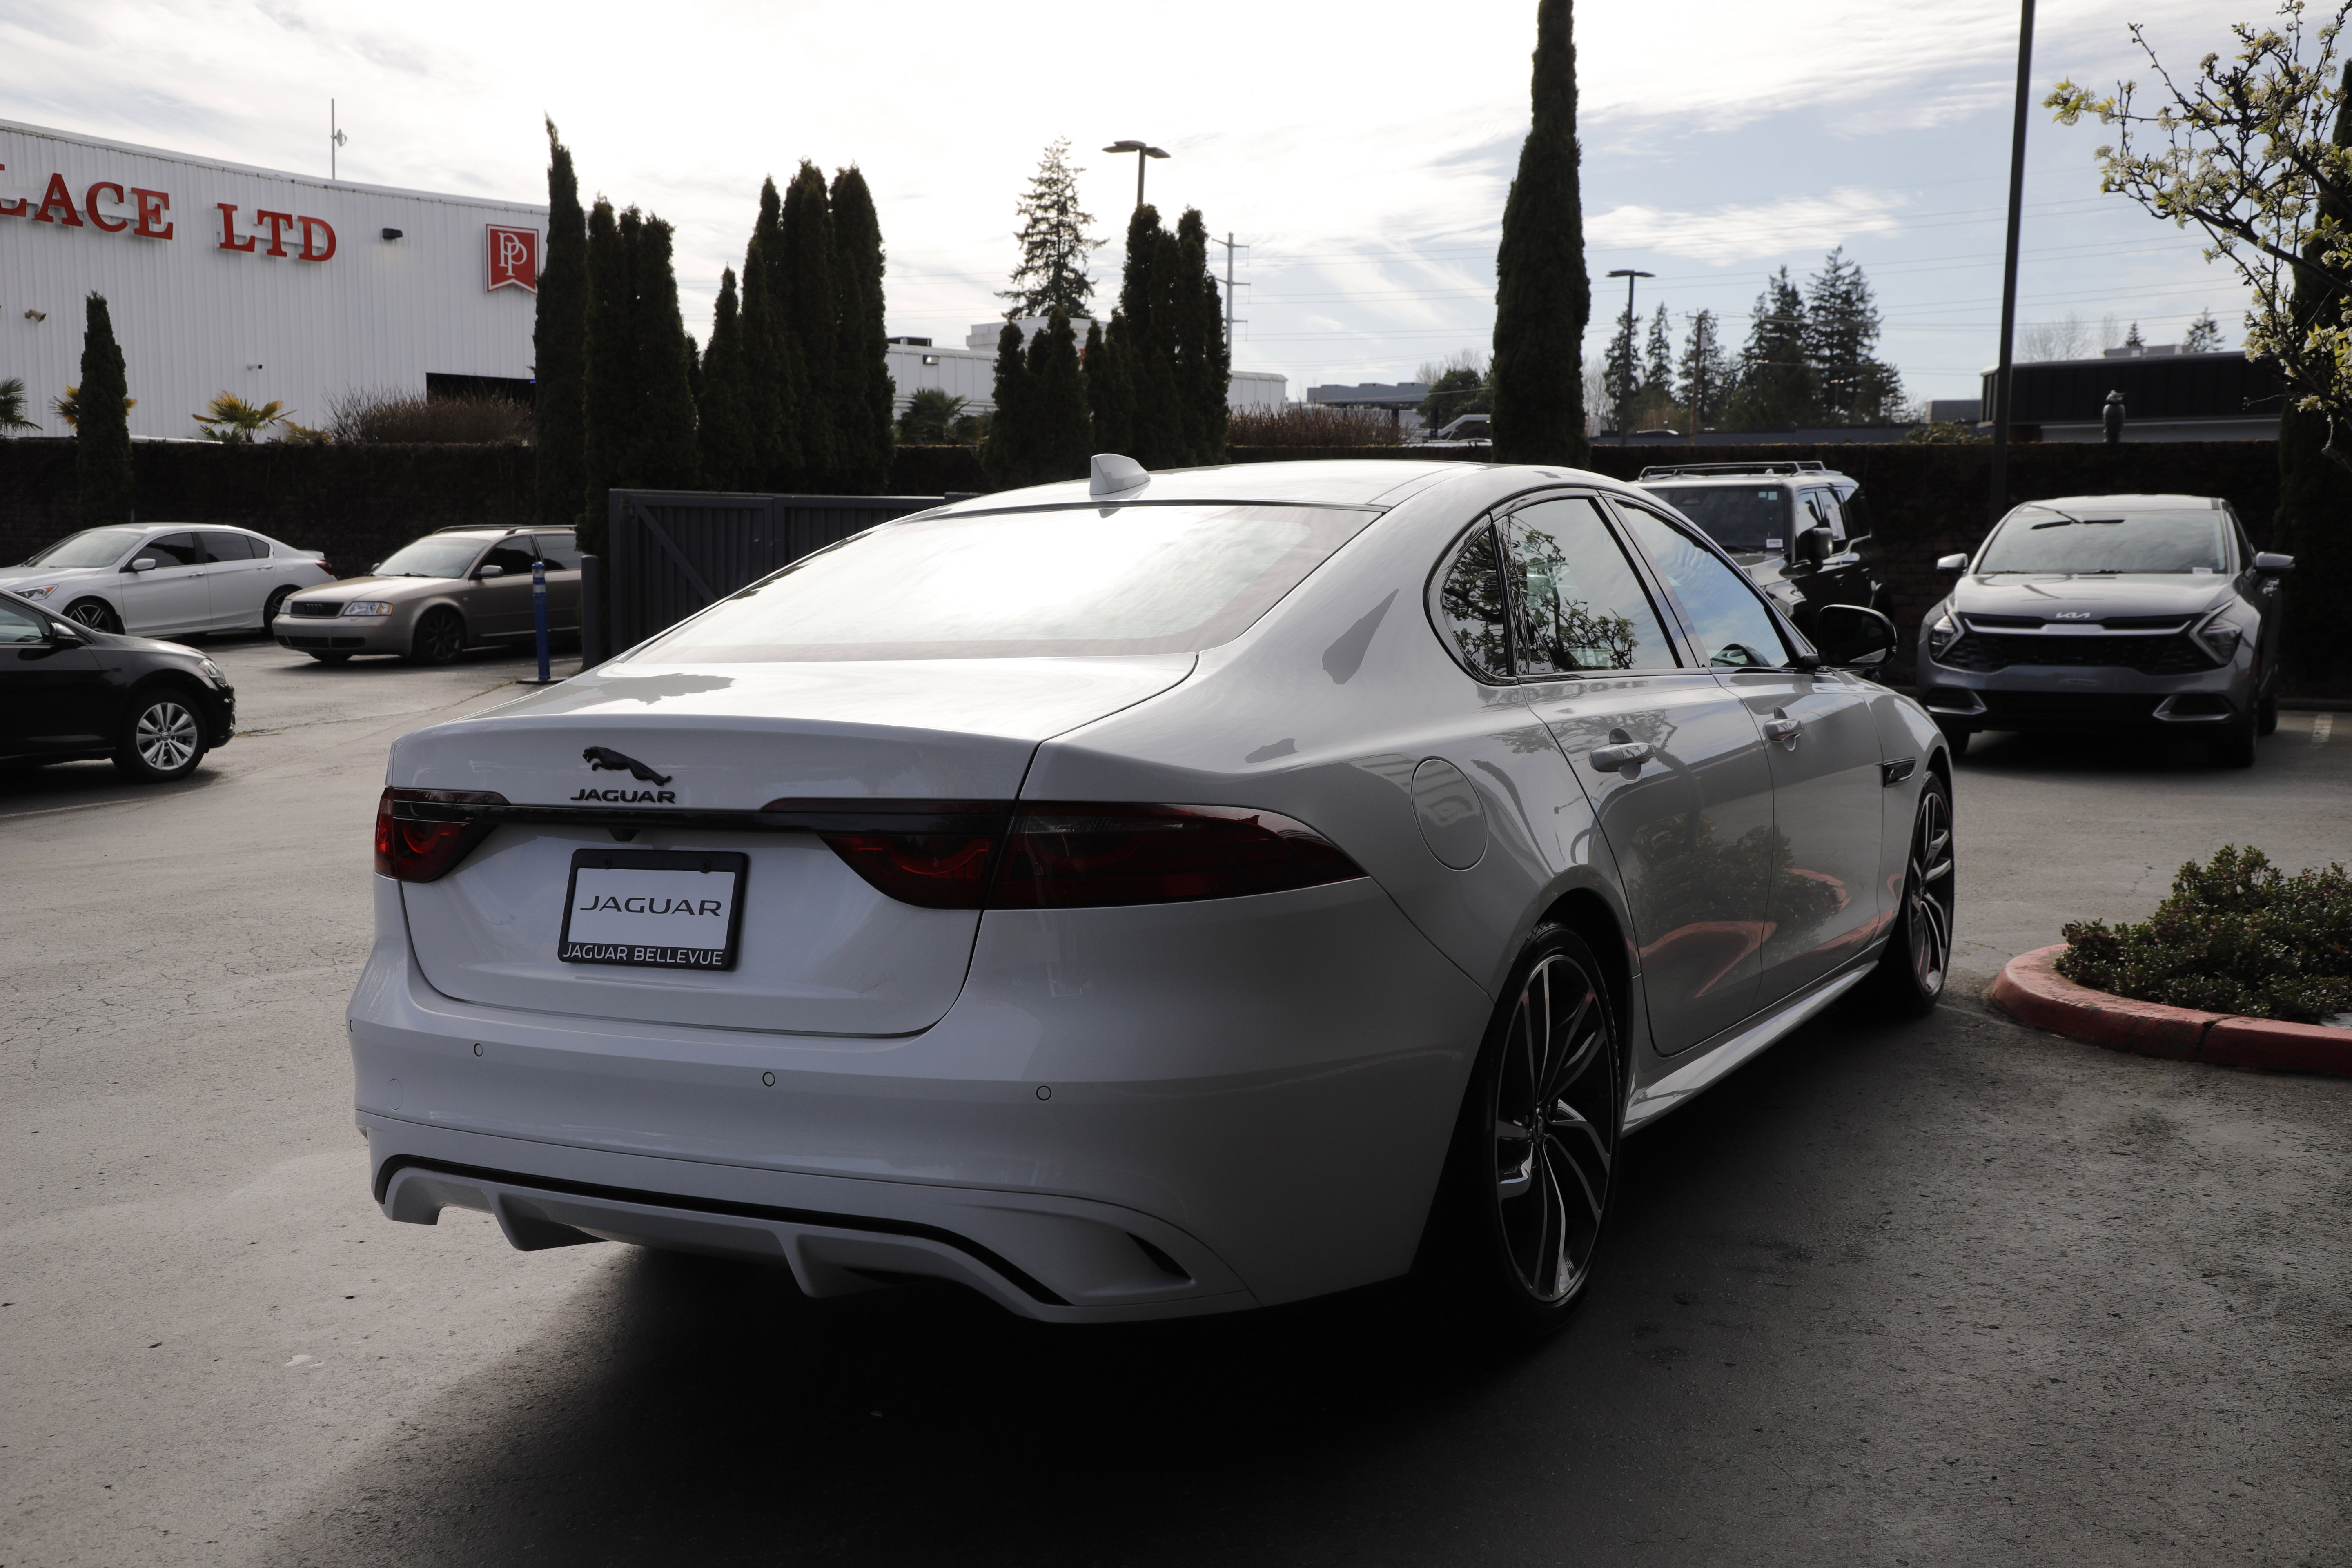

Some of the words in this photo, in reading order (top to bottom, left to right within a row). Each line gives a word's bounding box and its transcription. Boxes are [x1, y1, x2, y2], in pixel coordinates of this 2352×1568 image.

[217, 203, 336, 261] LTD
[570, 789, 675, 804] JAGUAR
[580, 895, 722, 917] JAGUAR
[562, 944, 628, 960] JAGUAR
[634, 947, 723, 965] BELLEVUE
